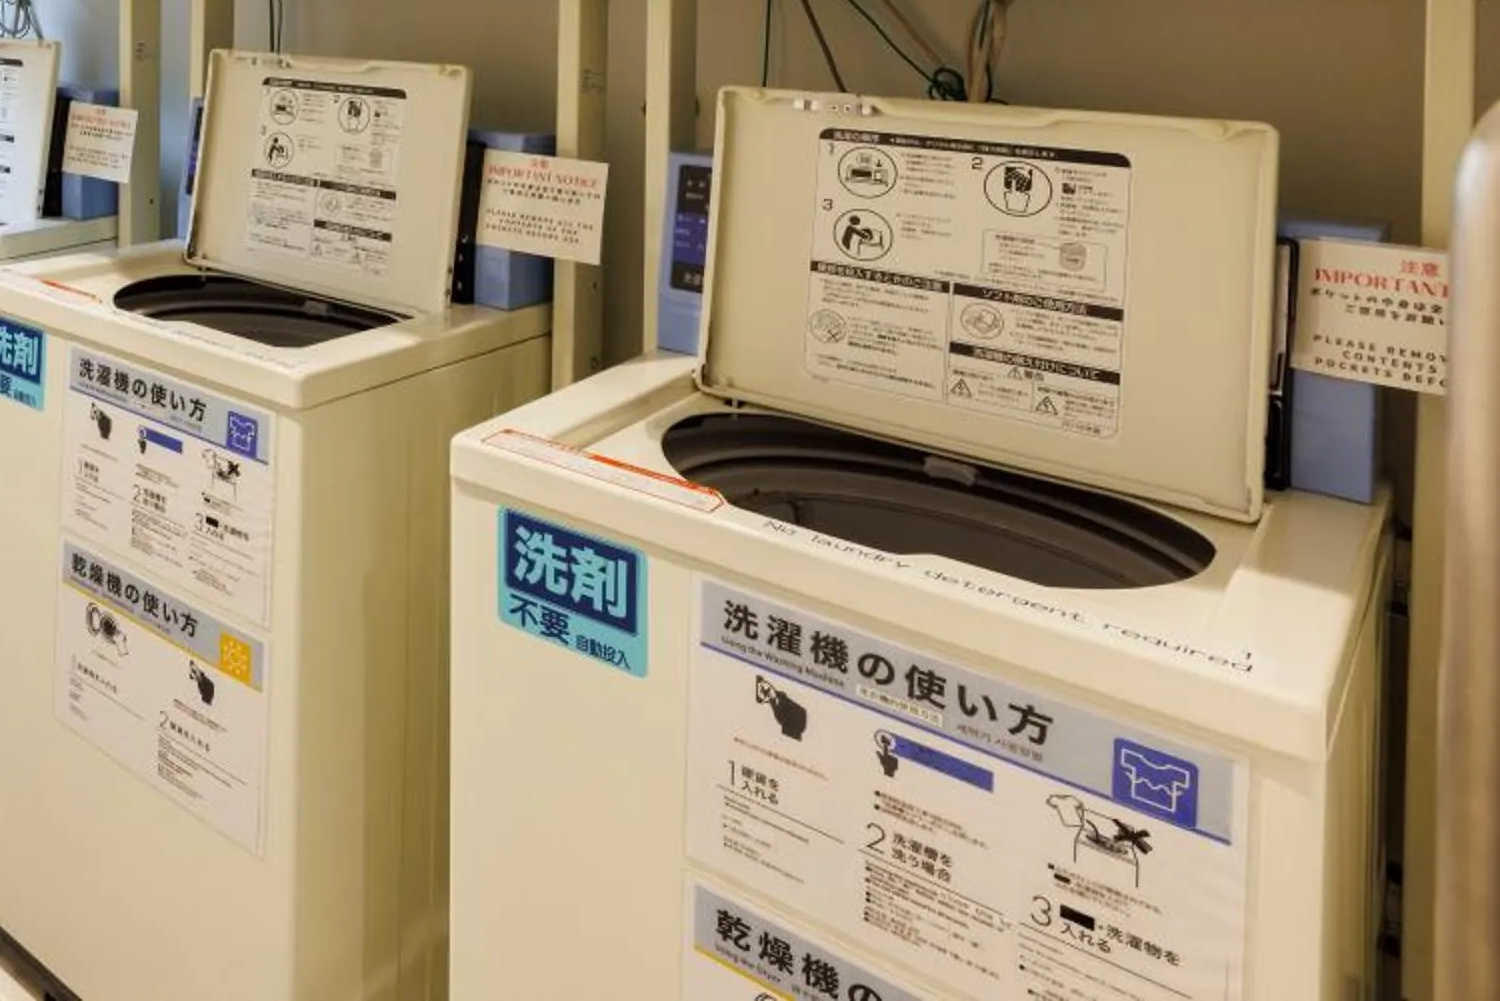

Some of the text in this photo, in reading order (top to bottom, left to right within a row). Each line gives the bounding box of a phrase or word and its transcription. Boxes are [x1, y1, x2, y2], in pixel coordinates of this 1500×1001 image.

[487, 164, 597, 187] IMPORTANT NOTICE
[970, 156, 984, 170] 2
[821, 198, 834, 211] 3
[1401, 260, 1439, 278] 注意
[1312, 334, 1377, 353] PLEASE
[1314, 356, 1393, 379] POCKETS
[1342, 350, 1438, 374] CONTENTS
[78, 356, 208, 423] 洗濯機の使い方
[132, 484, 141, 501] 2
[195, 512, 203, 532] 3
[512, 525, 630, 619] 洗剤
[70, 552, 198, 638] 乾燥機の使い方
[762, 519, 1253, 673] No laundry detergent required
[508, 592, 571, 646] 不要
[575, 634, 632, 671] 自動投入
[721, 635, 845, 687] Using the Washing Machine
[723, 599, 1054, 746] 洗濯機の使い方
[159, 710, 169, 730] 2
[726, 759, 736, 787] 1
[740, 779, 779, 805] 入れる
[866, 821, 887, 855] 2
[892, 832, 953, 868] 洗濯機を
[1030, 895, 1052, 928] 3
[1059, 922, 1112, 954] 入れる
